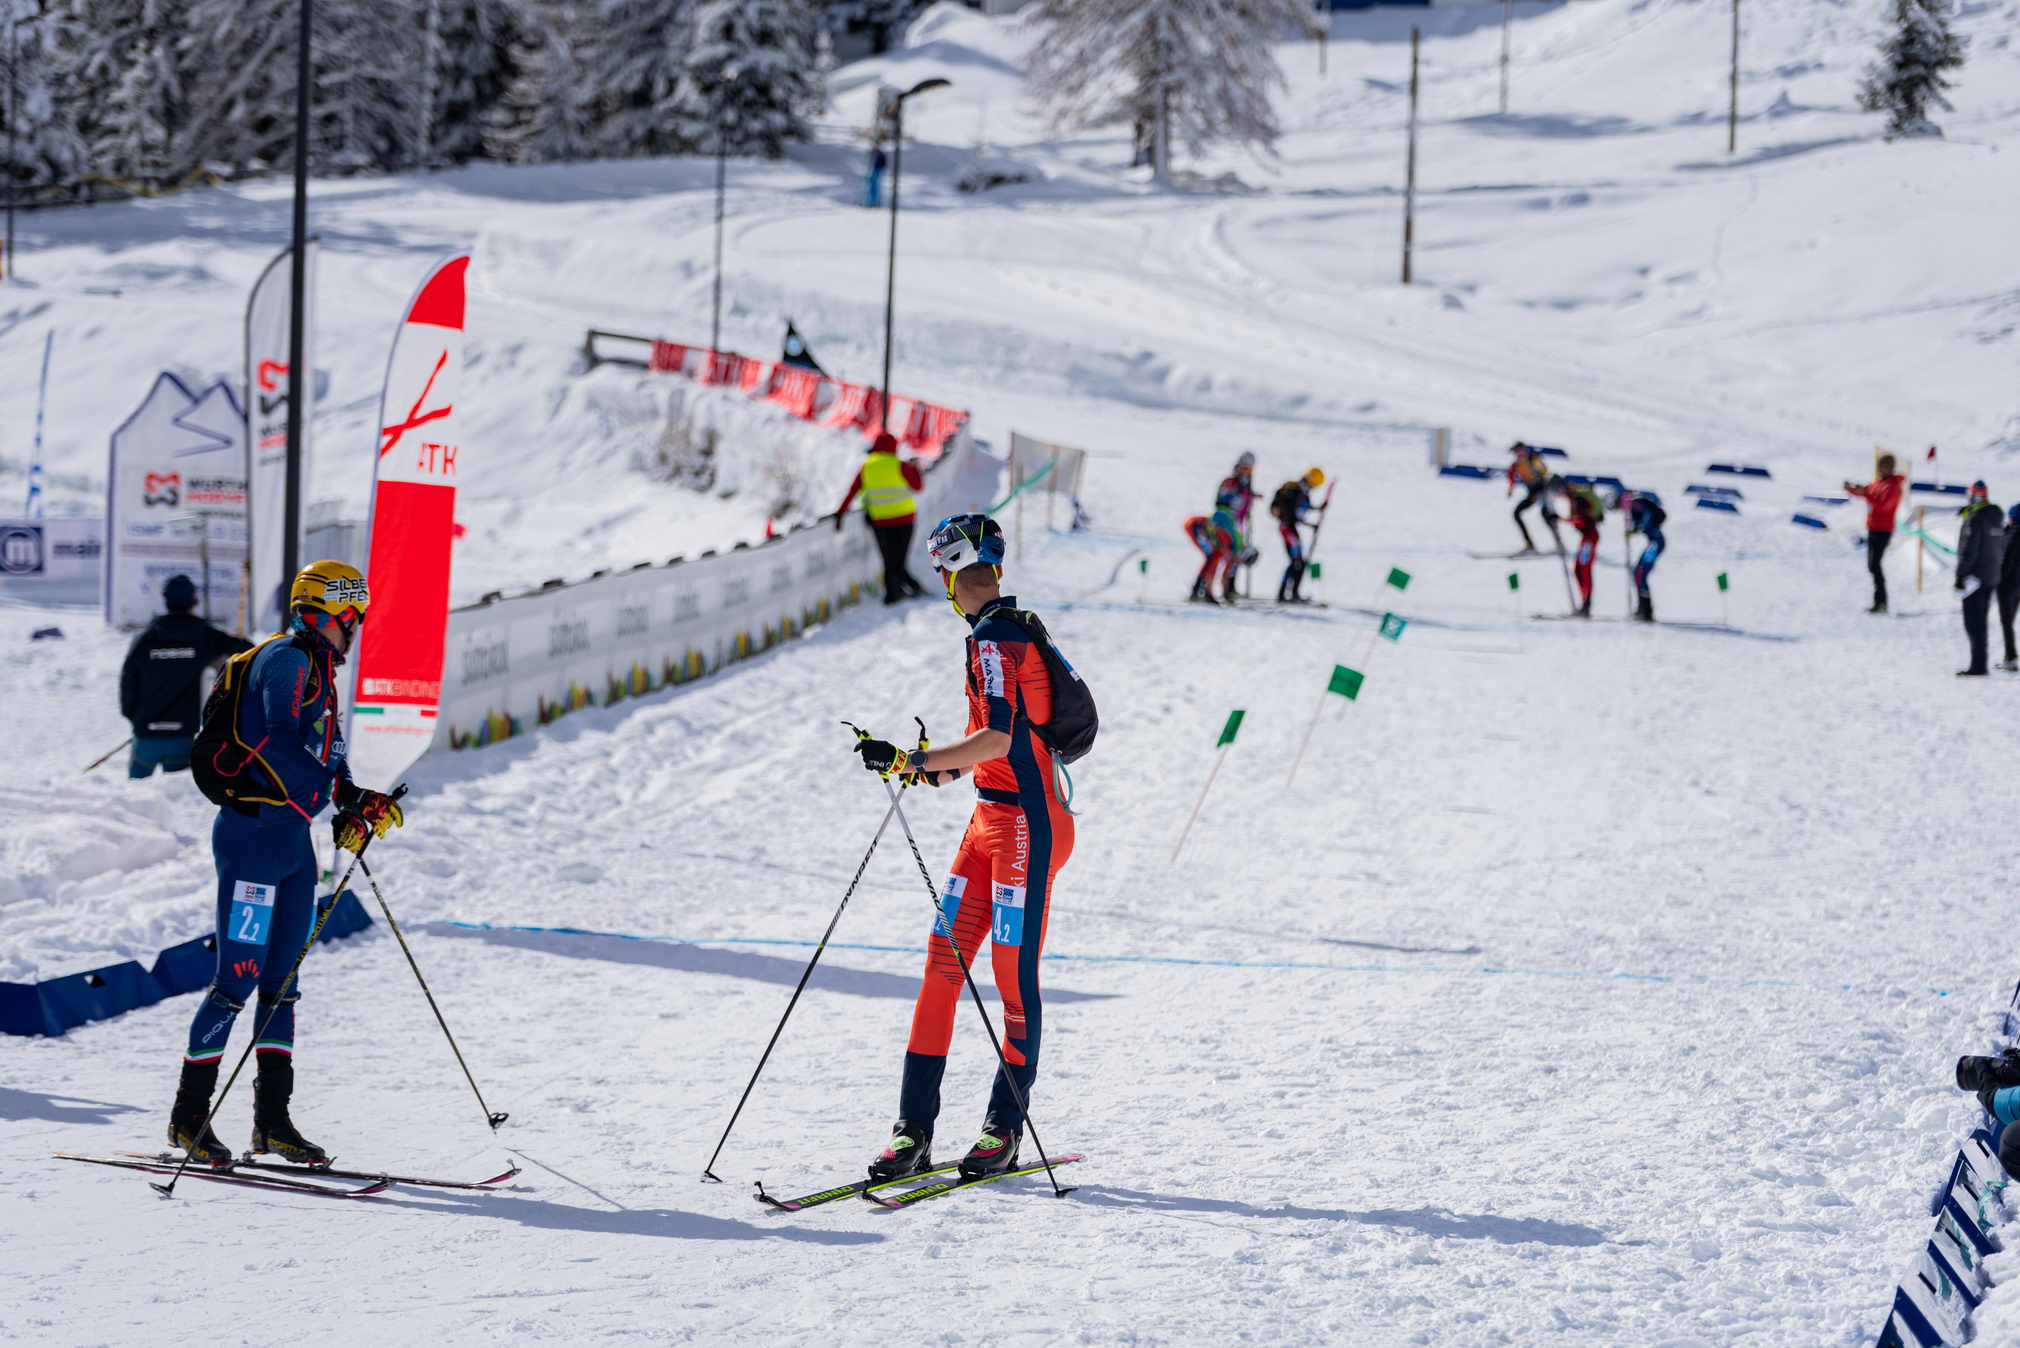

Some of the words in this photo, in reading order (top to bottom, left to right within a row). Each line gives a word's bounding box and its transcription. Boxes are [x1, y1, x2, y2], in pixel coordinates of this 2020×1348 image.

[840, 836, 881, 911] DYNAFIT
[907, 834, 944, 913] DYNAFIT
[1011, 814, 1026, 872] Austria
